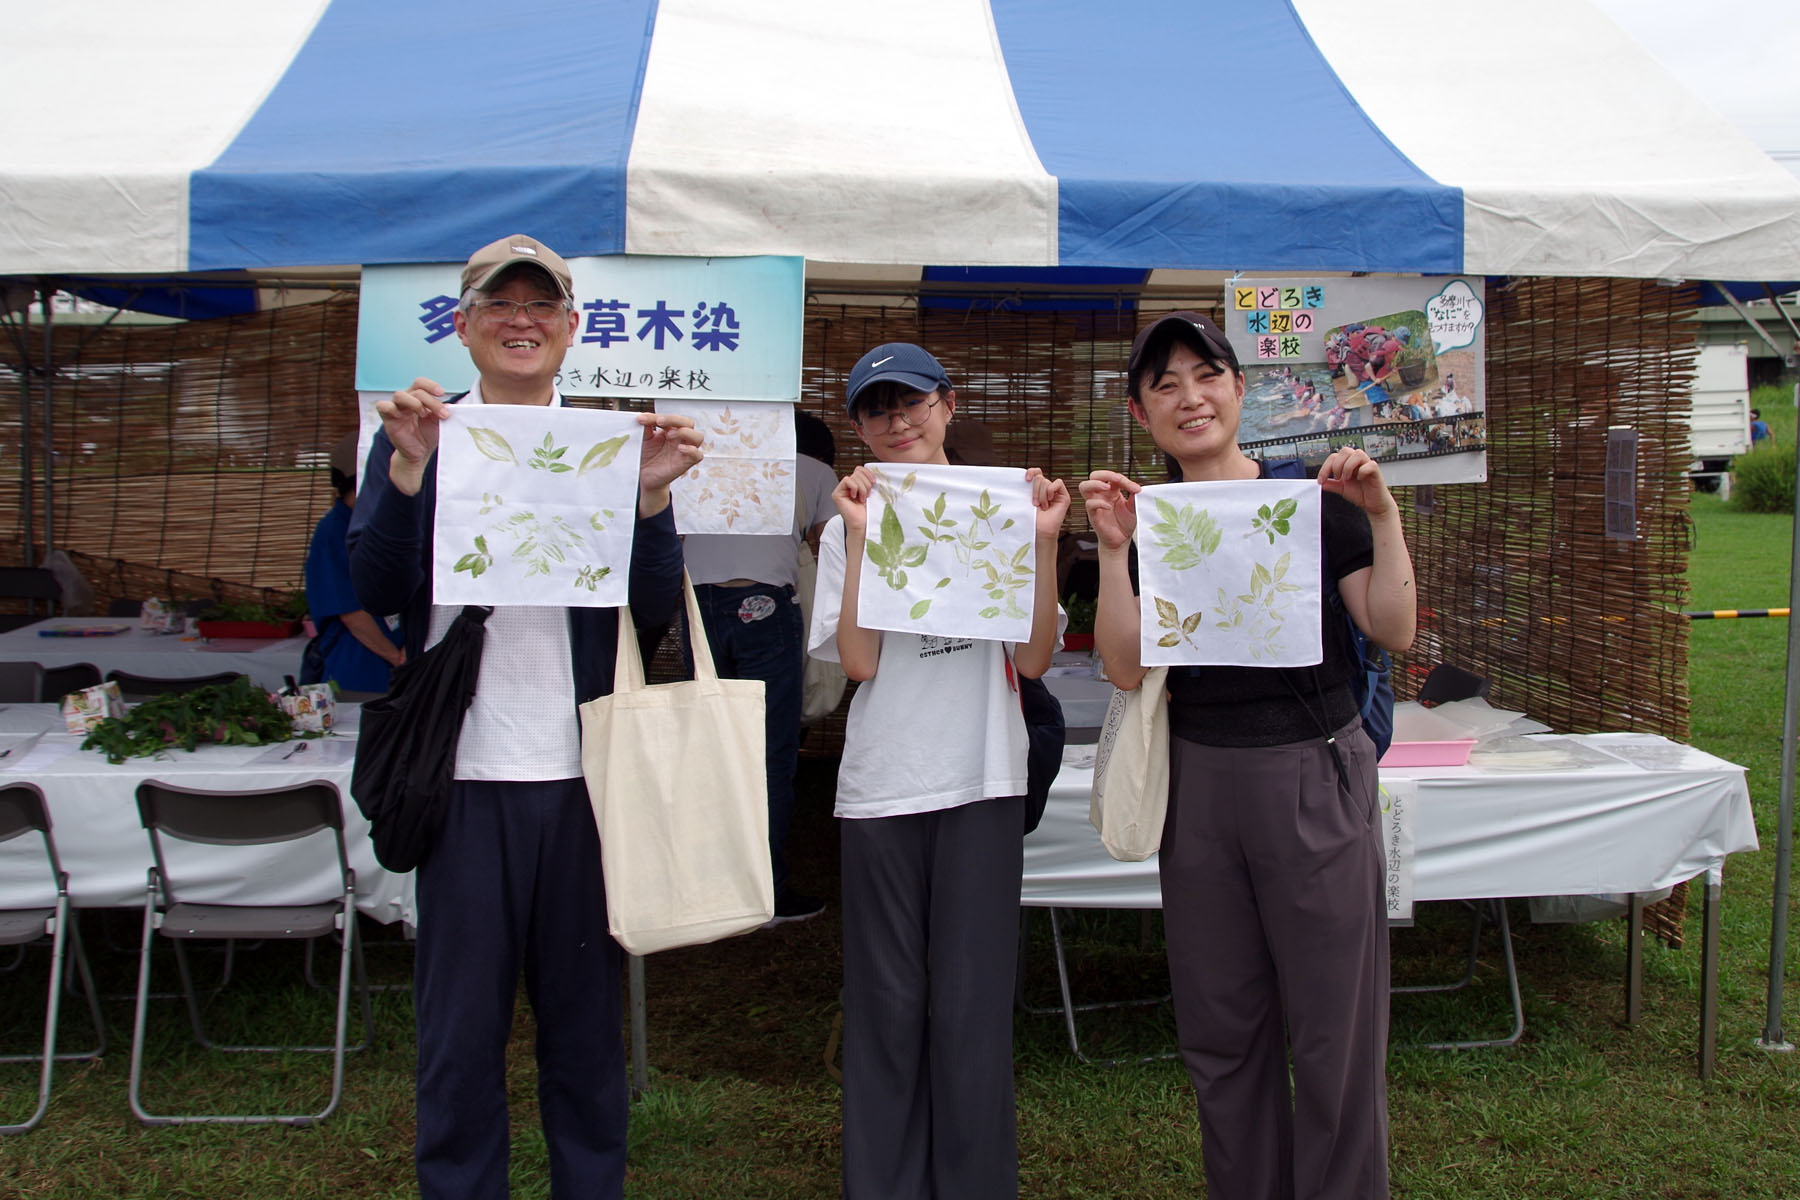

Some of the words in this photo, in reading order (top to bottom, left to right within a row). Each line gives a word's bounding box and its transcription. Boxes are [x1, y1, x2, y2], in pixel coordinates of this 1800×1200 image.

[1237, 286, 1322, 309] とどろき
[417, 294, 741, 352] 多草木染
[1249, 312, 1312, 333] 水辺の
[1260, 336, 1301, 357] 楽校
[1387, 795, 1404, 912] とどろき水辺の楽校
